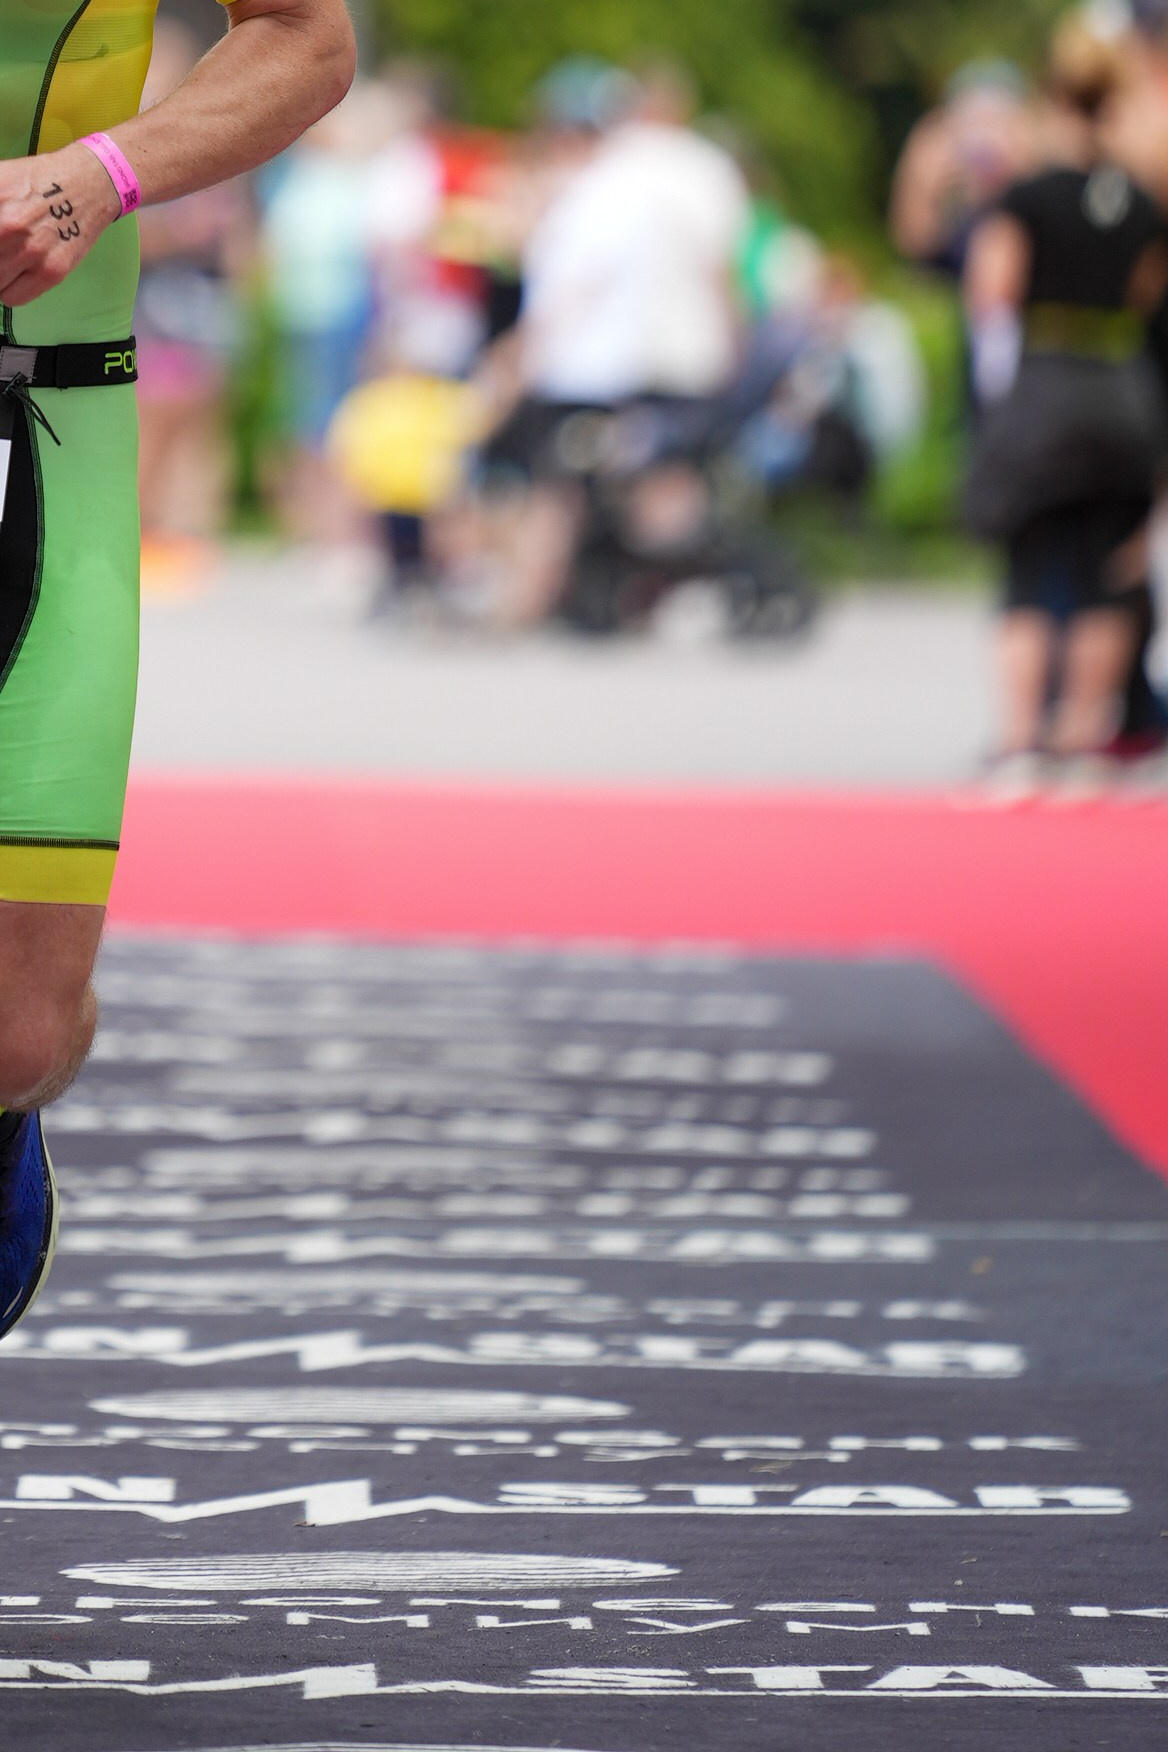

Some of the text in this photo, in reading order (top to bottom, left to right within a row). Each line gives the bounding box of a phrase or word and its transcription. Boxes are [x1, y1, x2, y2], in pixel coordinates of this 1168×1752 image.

[42, 182, 80, 242] 133
[104, 349, 136, 375] PO
[494, 1482, 1129, 1509] STAR
